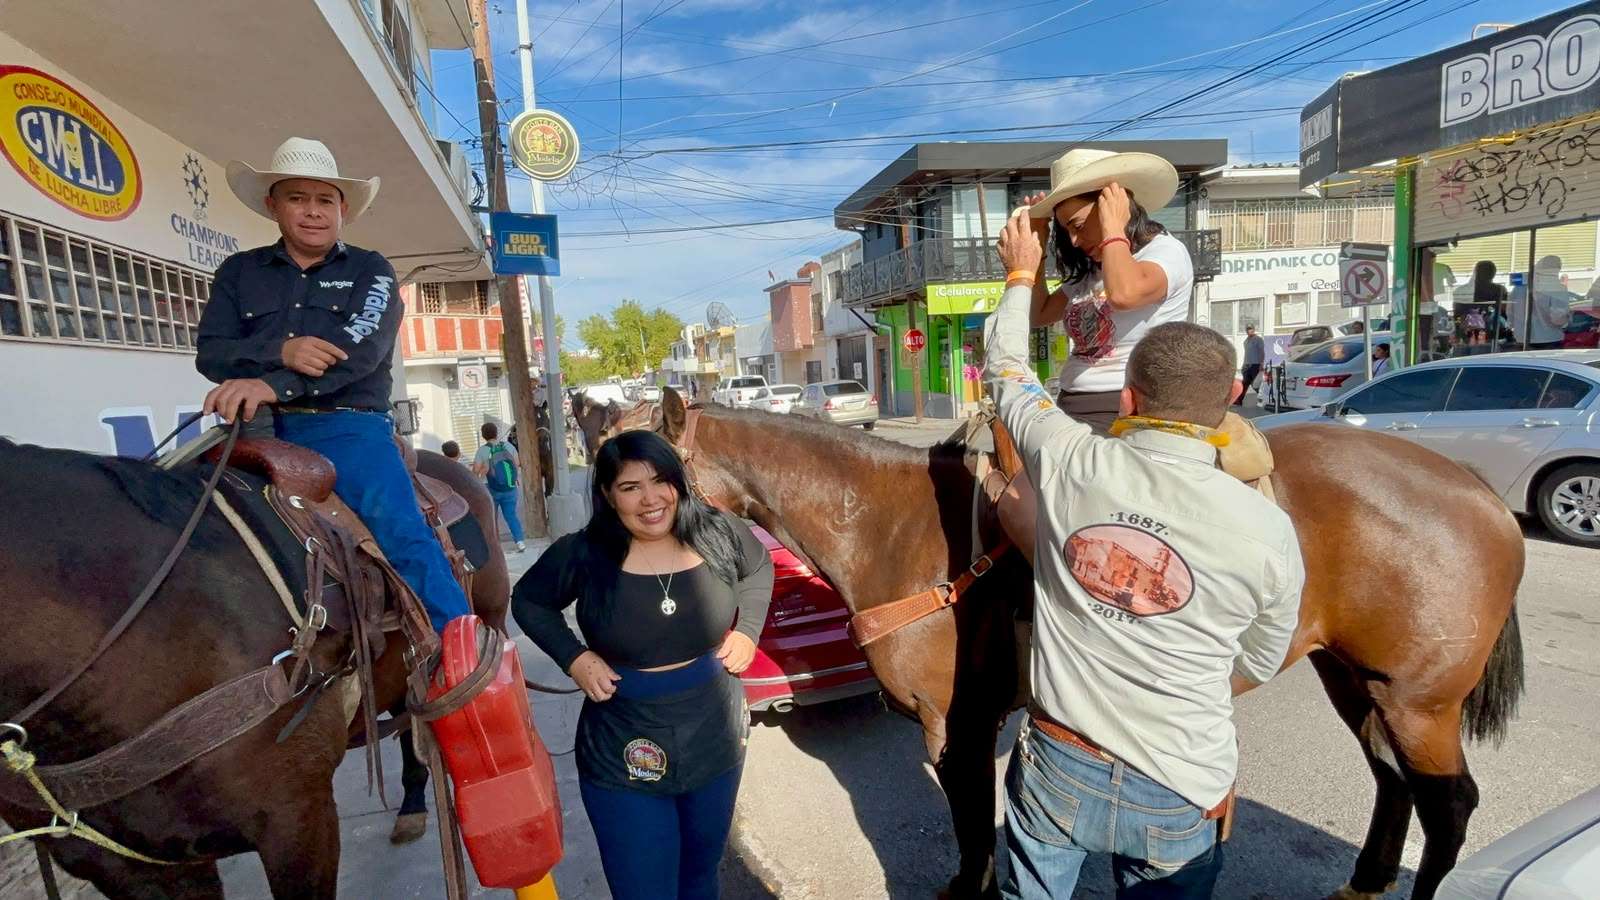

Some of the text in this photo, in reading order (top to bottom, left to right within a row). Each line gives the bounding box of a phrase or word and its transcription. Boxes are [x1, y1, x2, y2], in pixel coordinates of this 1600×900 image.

[13, 83, 114, 146] CONSEJO MUNDIAL
[20, 111, 115, 193] CMLL
[28, 156, 122, 215] DE LUCHA LIBRE
[171, 213, 240, 252] CHAMPIONS
[503, 243, 547, 256] LIGHT
[510, 233, 541, 244] BUD
[905, 335, 924, 346] ALTO
